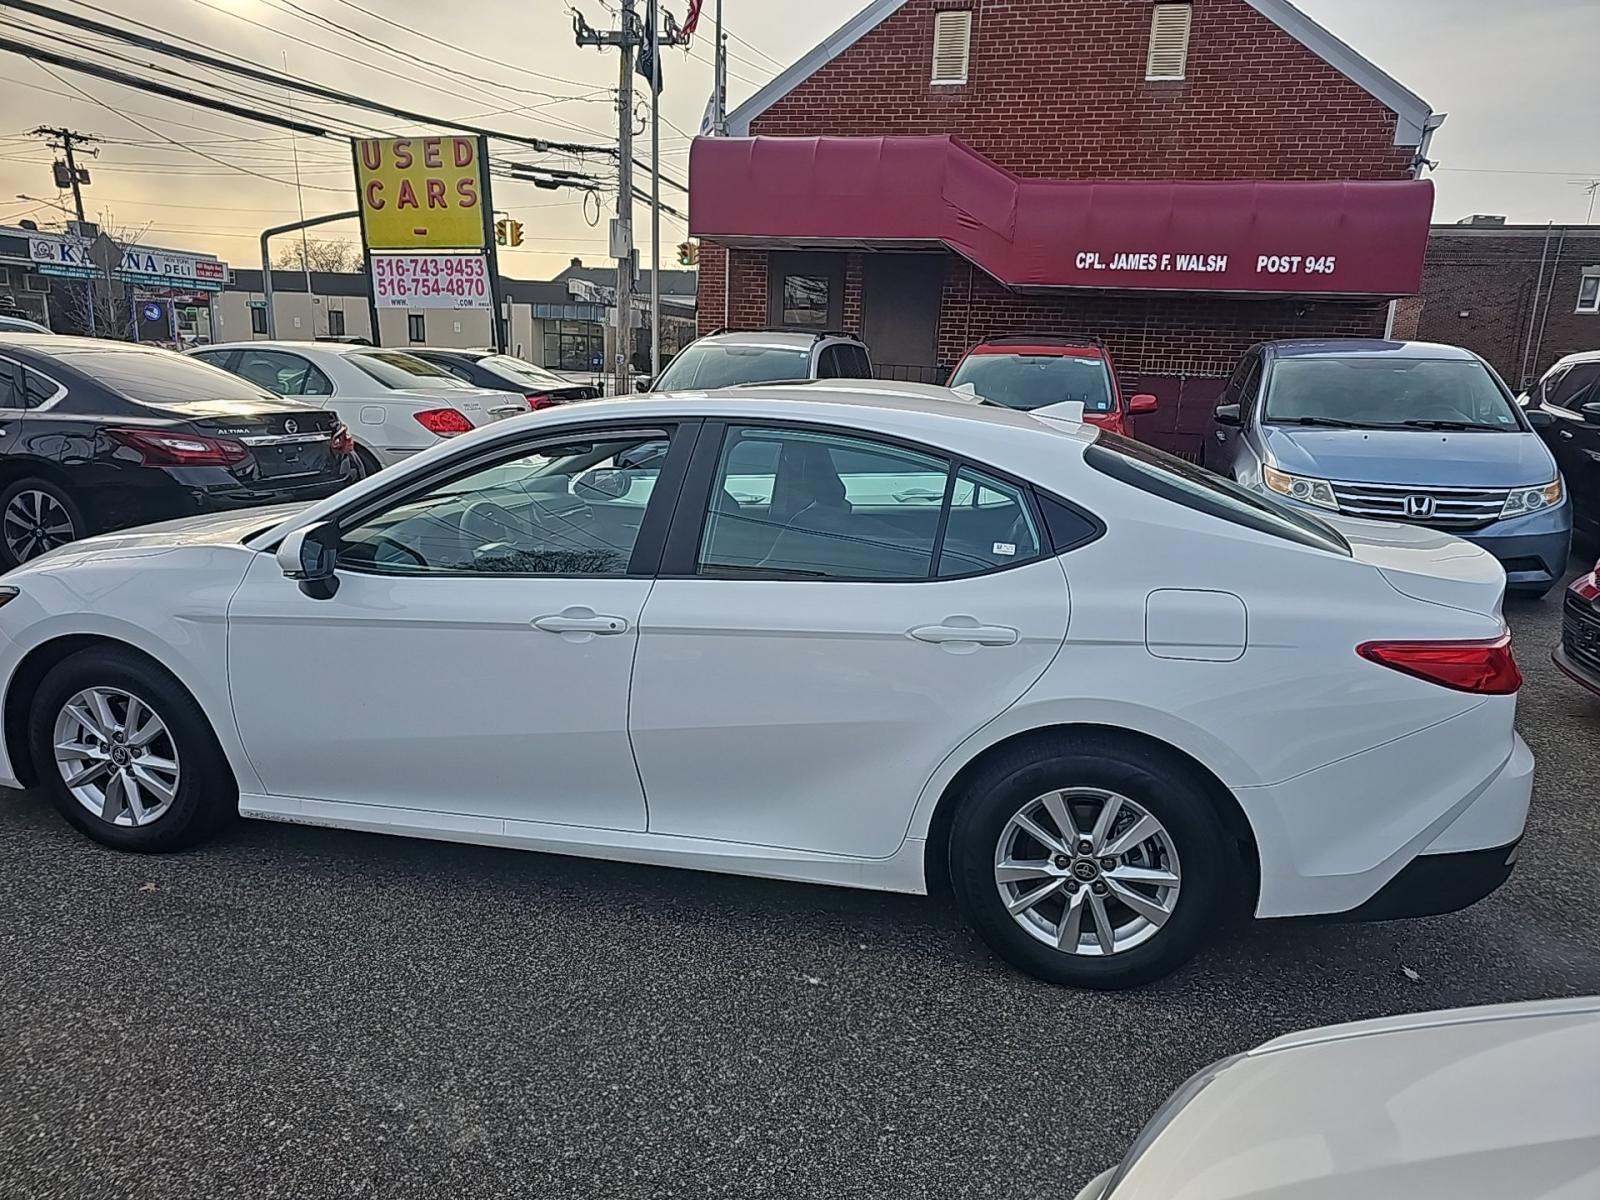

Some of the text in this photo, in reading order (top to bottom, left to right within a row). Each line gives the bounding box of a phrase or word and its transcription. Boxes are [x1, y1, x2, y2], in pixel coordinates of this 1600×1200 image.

[361, 137, 473, 170] USED
[366, 179, 478, 210] CARS
[164, 263, 191, 276] DELI
[376, 258, 484, 276] 516-743-9453
[1076, 252, 1336, 274] CPL. JAMES F. WALSH POST 945
[378, 278, 485, 296] 516-754-4870
